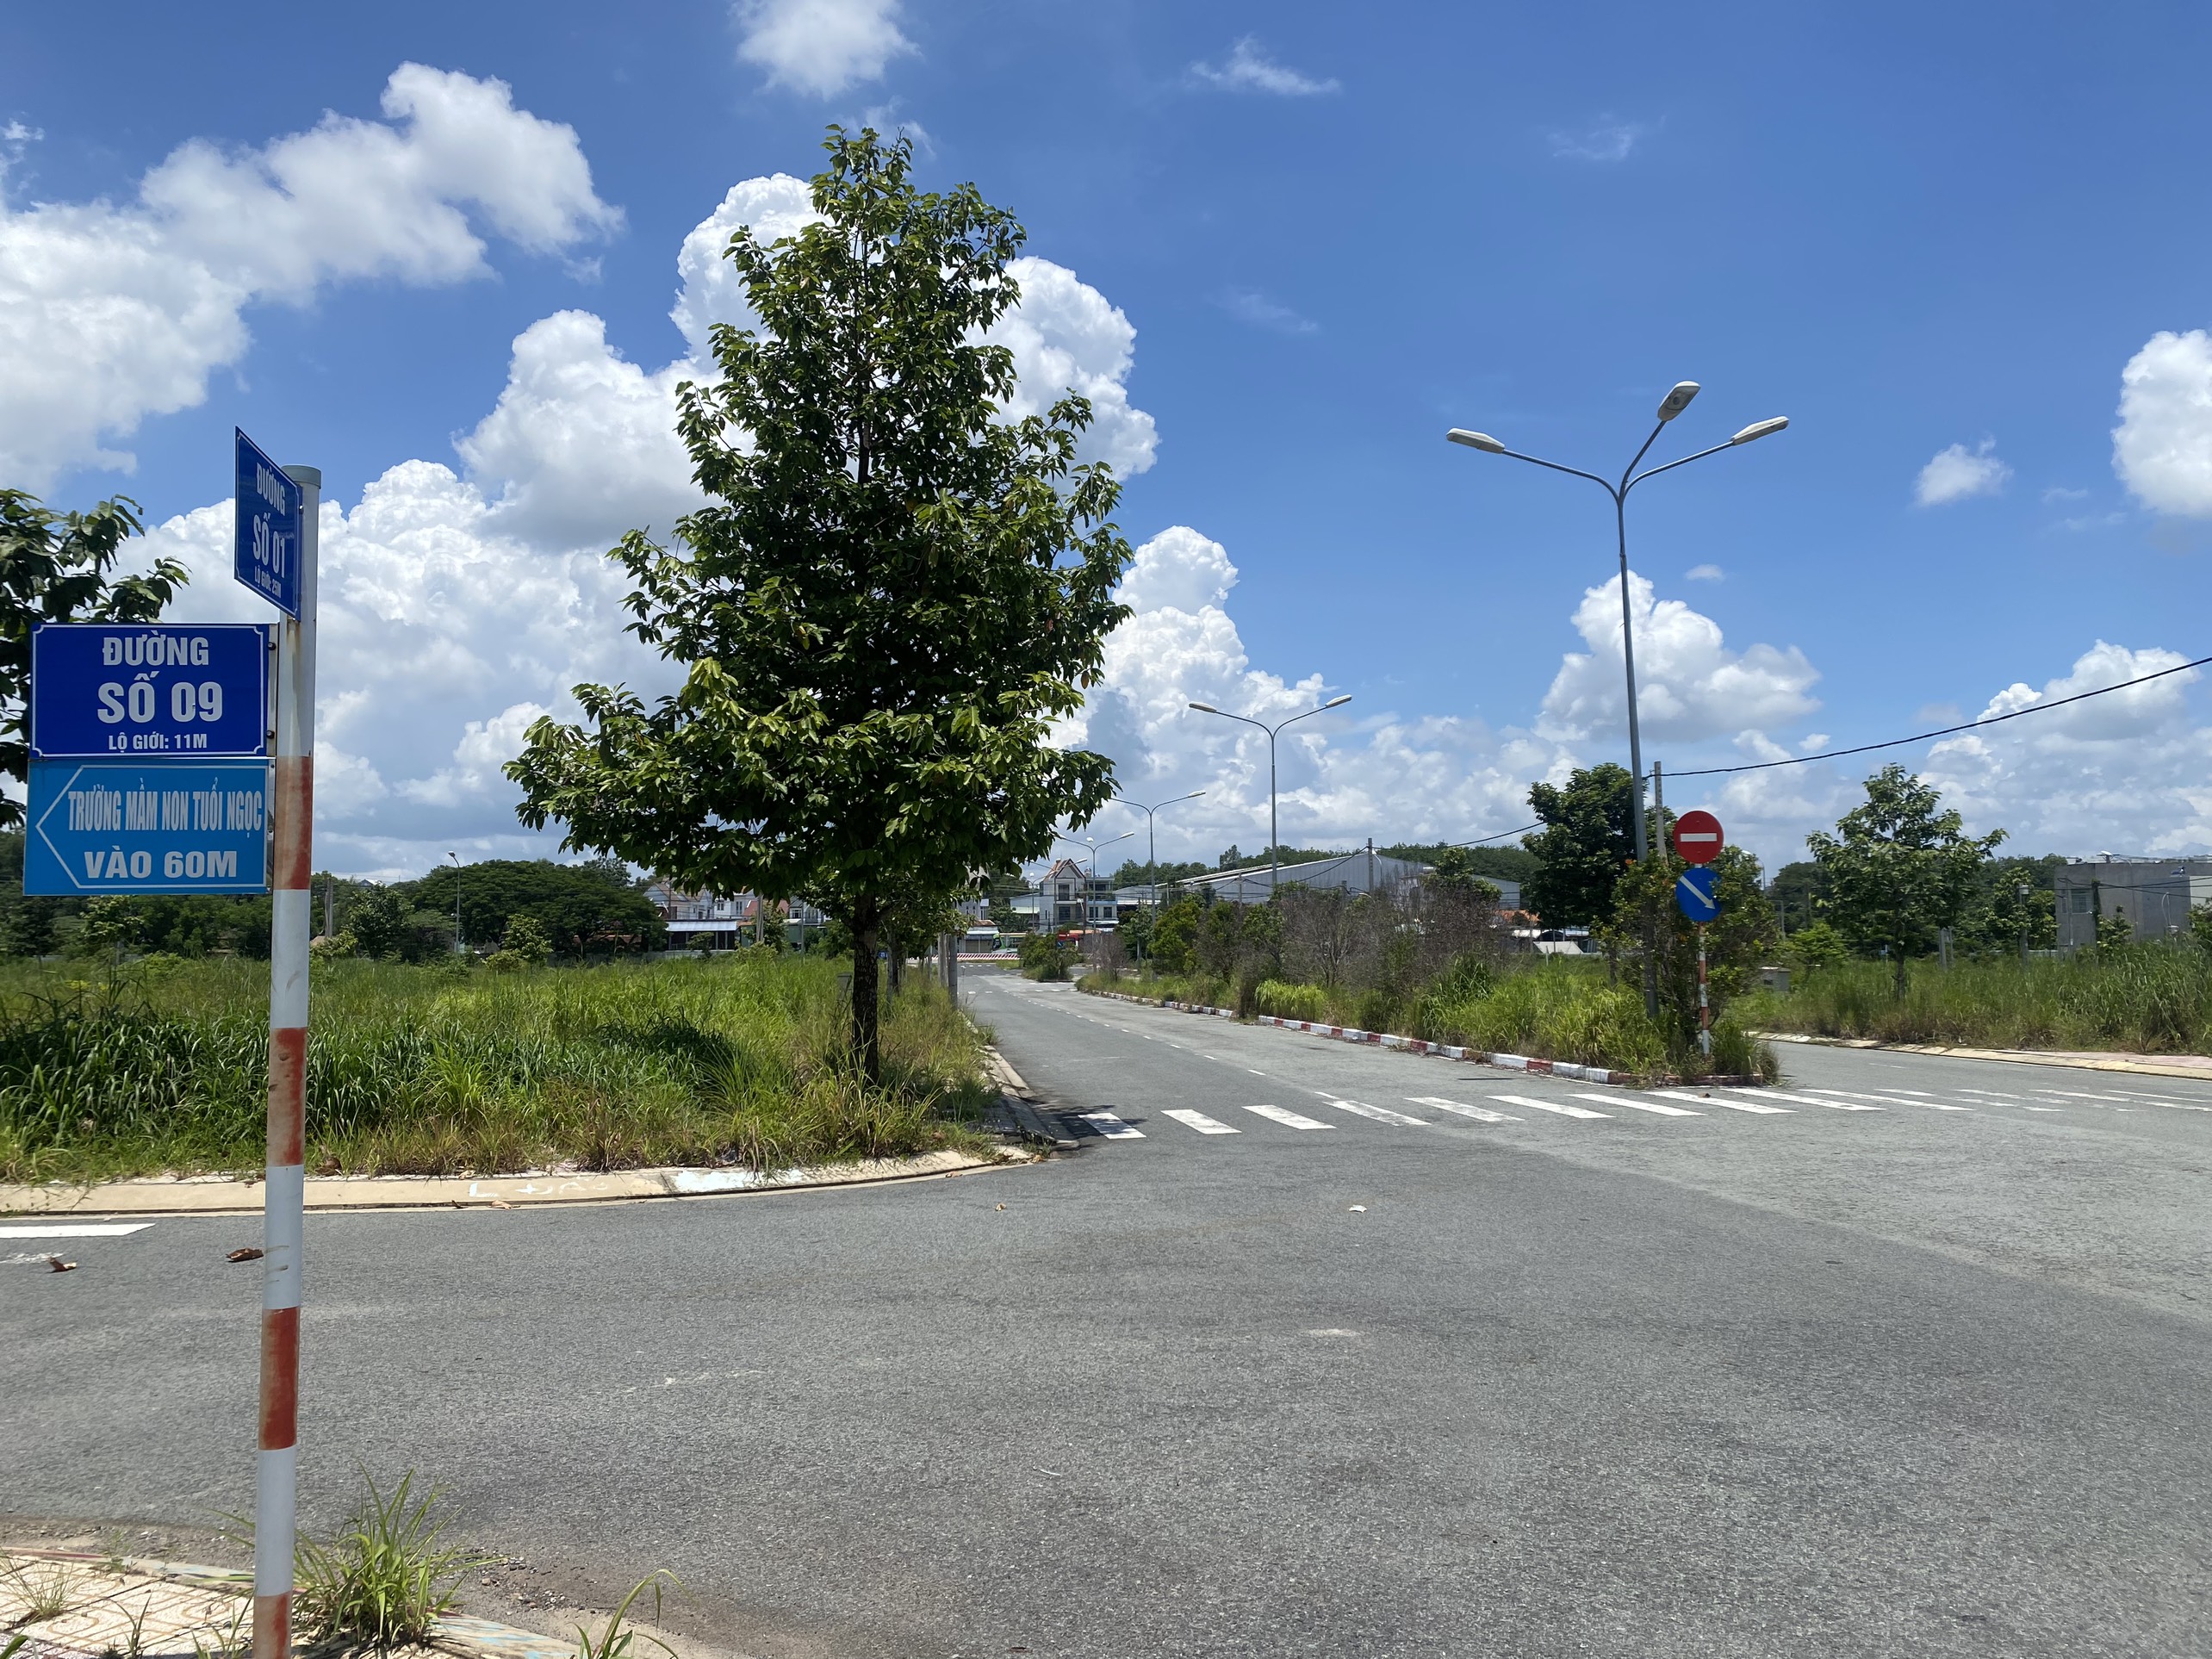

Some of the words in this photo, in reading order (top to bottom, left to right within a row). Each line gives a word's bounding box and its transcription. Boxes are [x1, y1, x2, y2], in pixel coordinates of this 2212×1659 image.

[256, 462, 286, 516] ĐƯỜNG
[252, 513, 271, 566] SỐ
[272, 531, 285, 579] 01
[102, 630, 209, 666] ĐƯỜNG
[96, 670, 160, 724] SỐ
[171, 681, 223, 723] 09
[109, 732, 127, 753] LỘ
[133, 731, 170, 749] GIỚI:
[174, 733, 208, 749] 11M
[68, 784, 121, 831] TRƯỜNG
[125, 777, 158, 831] MẦM
[161, 790, 190, 831] NON
[192, 776, 223, 831] TUỔI
[227, 790, 263, 838] NGỌC
[84, 845, 152, 879] VÀO
[164, 850, 237, 879] 60M
